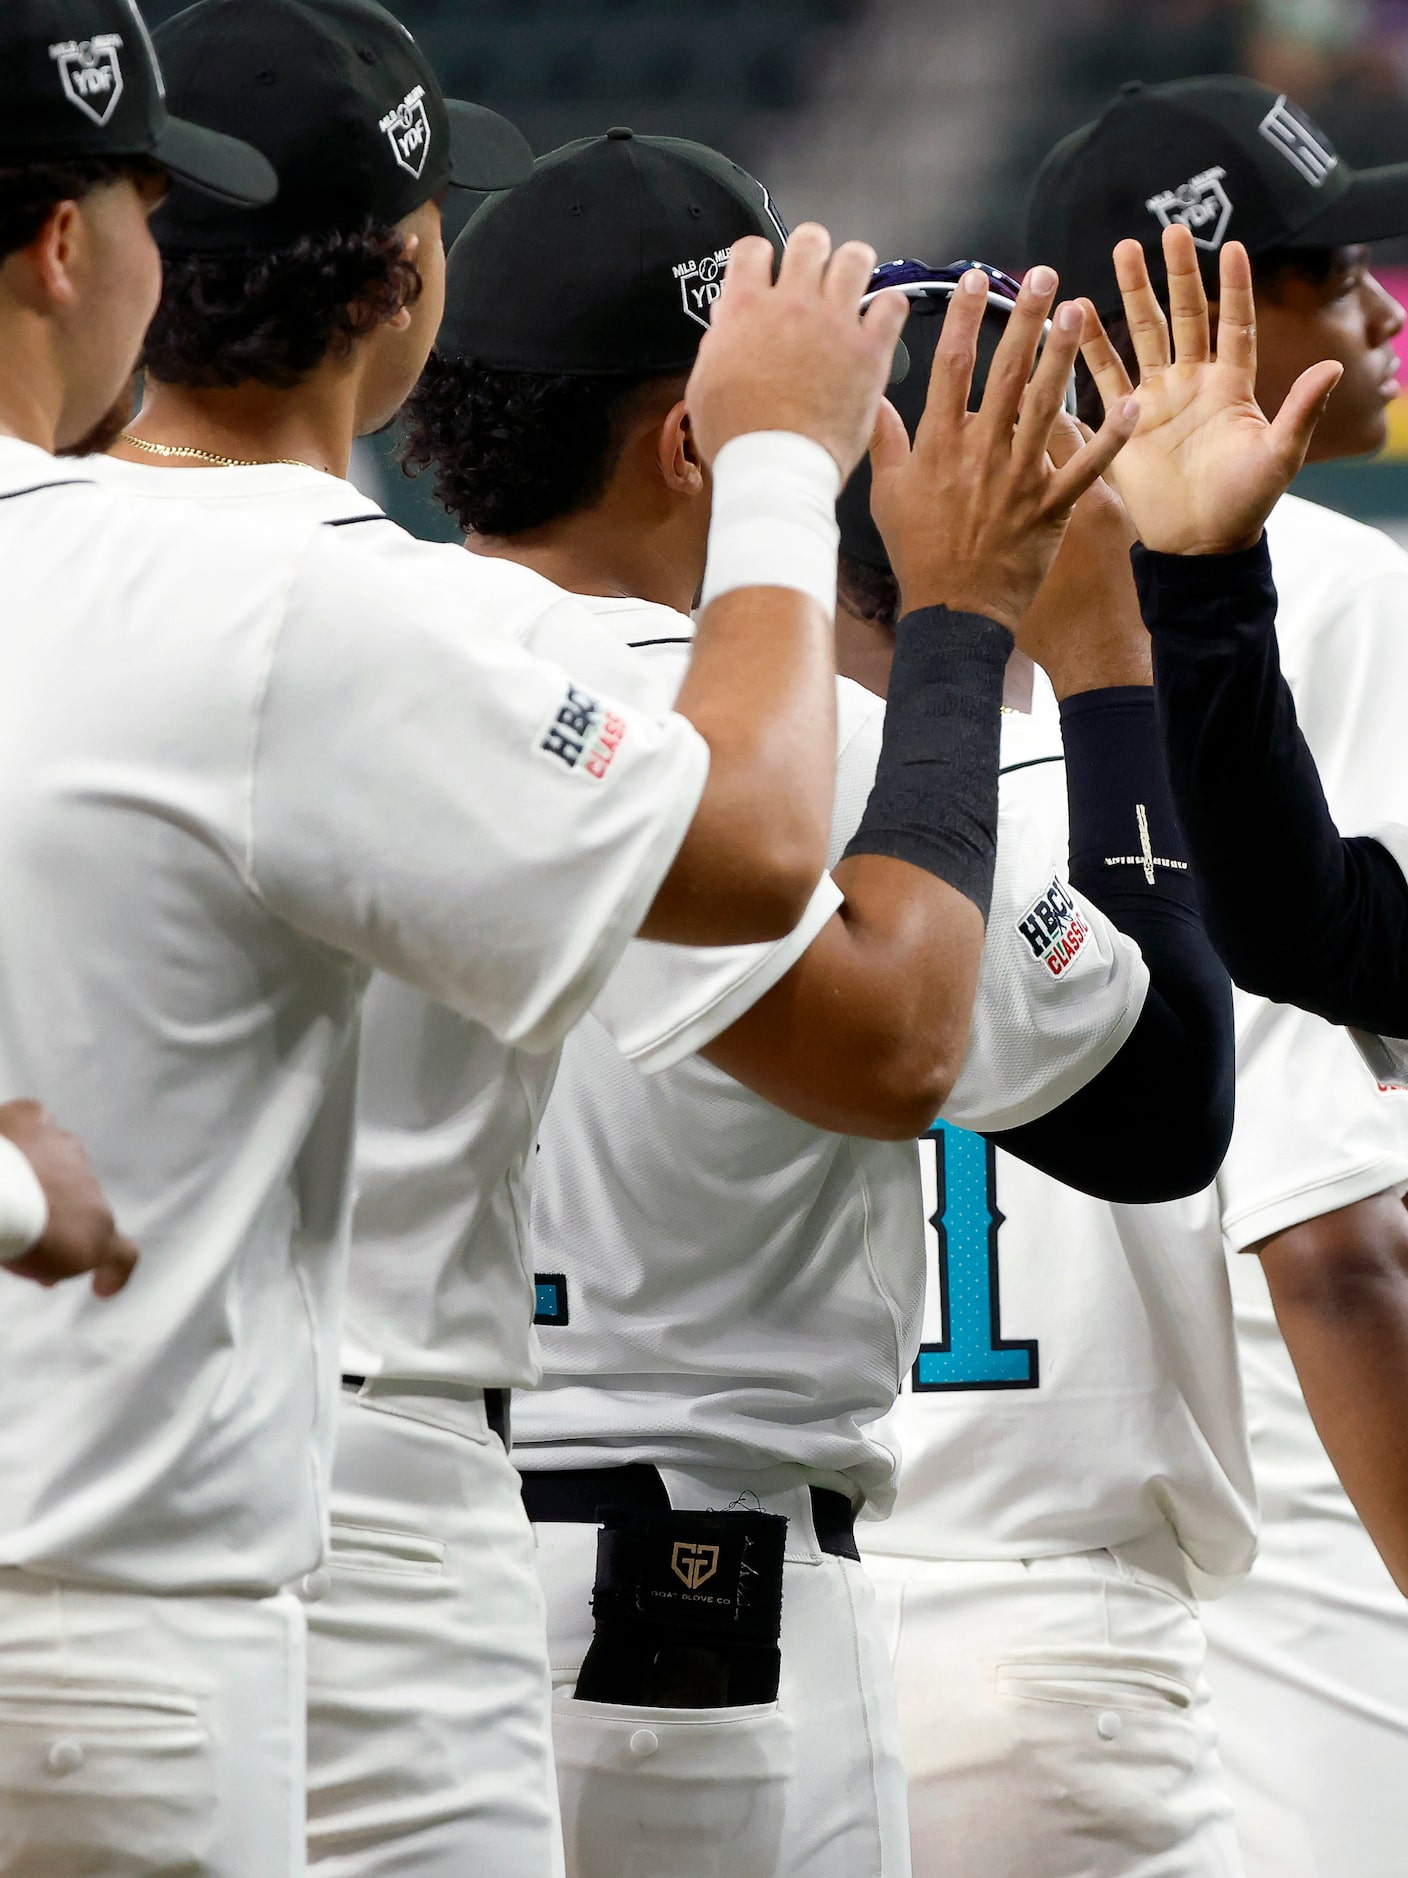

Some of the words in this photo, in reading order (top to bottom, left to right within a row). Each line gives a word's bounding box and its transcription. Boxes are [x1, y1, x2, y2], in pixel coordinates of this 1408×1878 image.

[398, 118, 424, 157] YDF
[672, 260, 697, 278] MLB
[690, 279, 726, 308] YD
[1018, 874, 1074, 958] HBCU
[1047, 911, 1089, 975] CLASSIC
[897, 1117, 1040, 1394] 1
[681, 1593, 714, 1603] GLOVE
[716, 1597, 731, 1605] CO
